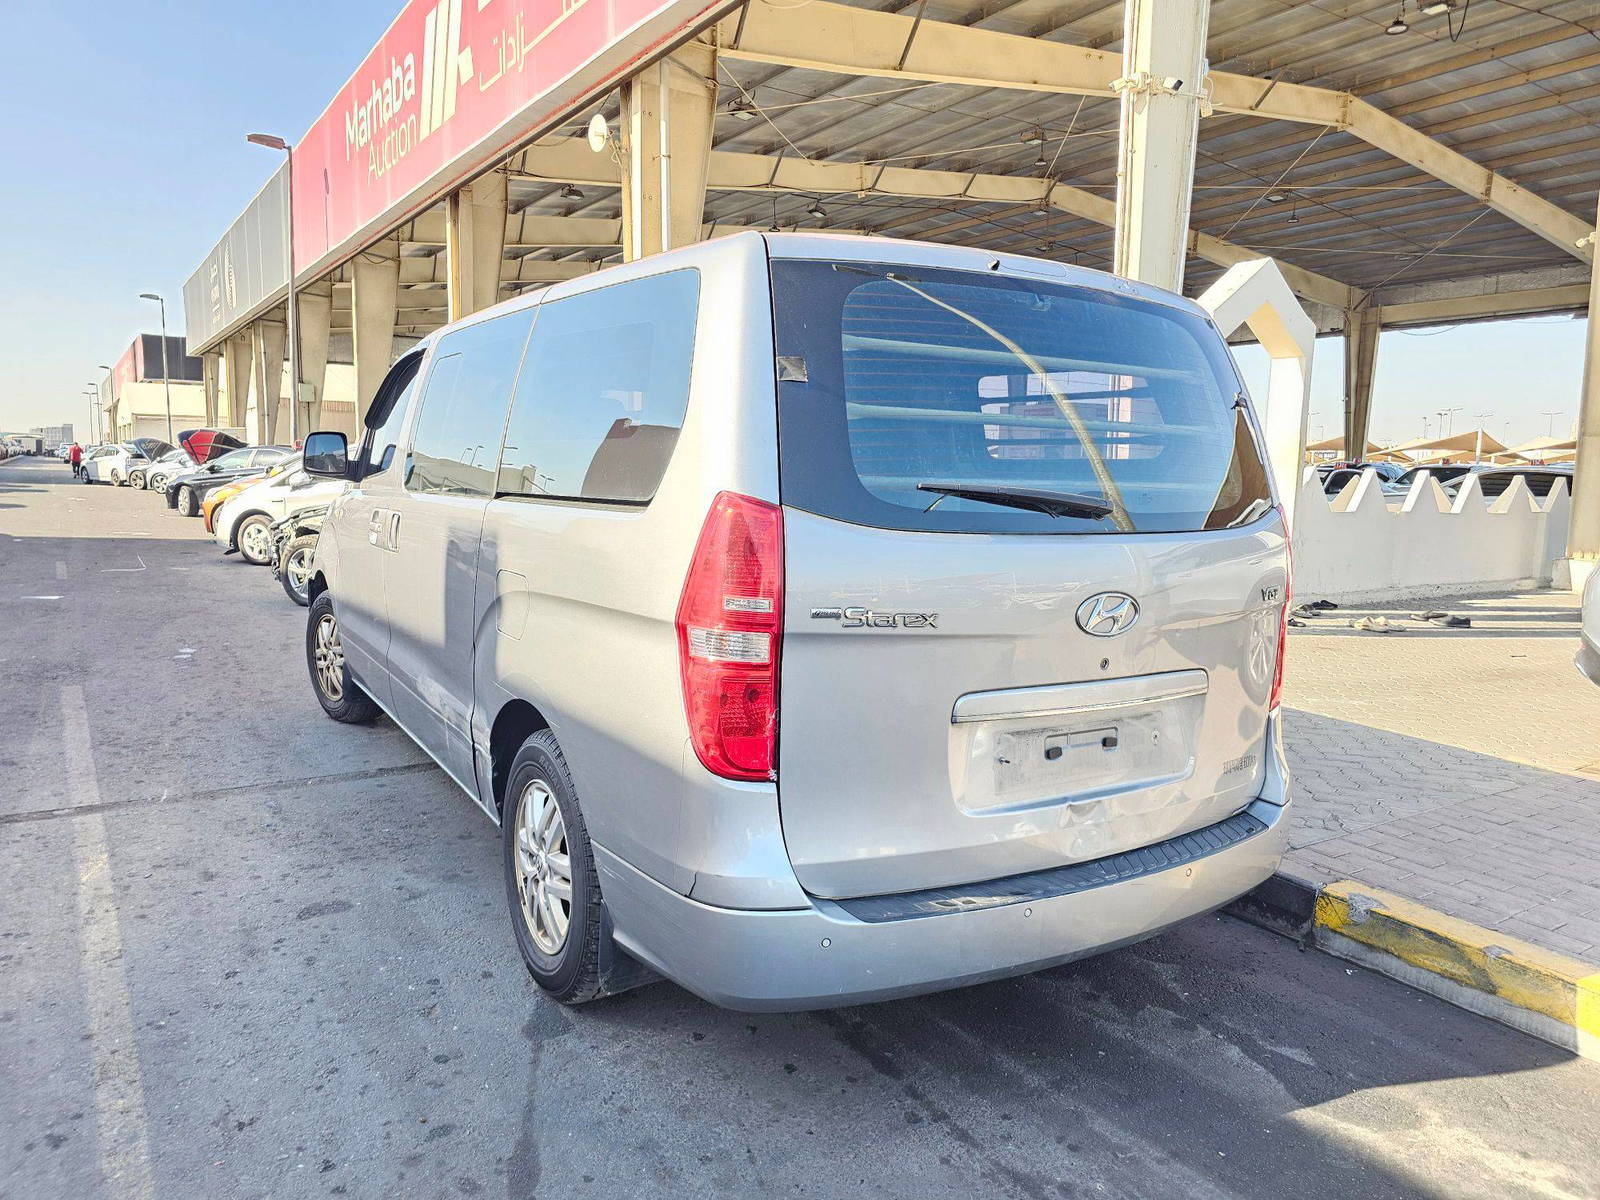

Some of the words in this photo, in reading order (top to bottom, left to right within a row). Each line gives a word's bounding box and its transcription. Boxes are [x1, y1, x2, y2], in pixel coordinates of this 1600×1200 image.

[345, 51, 416, 162] Marhaba
[367, 112, 418, 186] Auction
[842, 606, 939, 629] Starex
